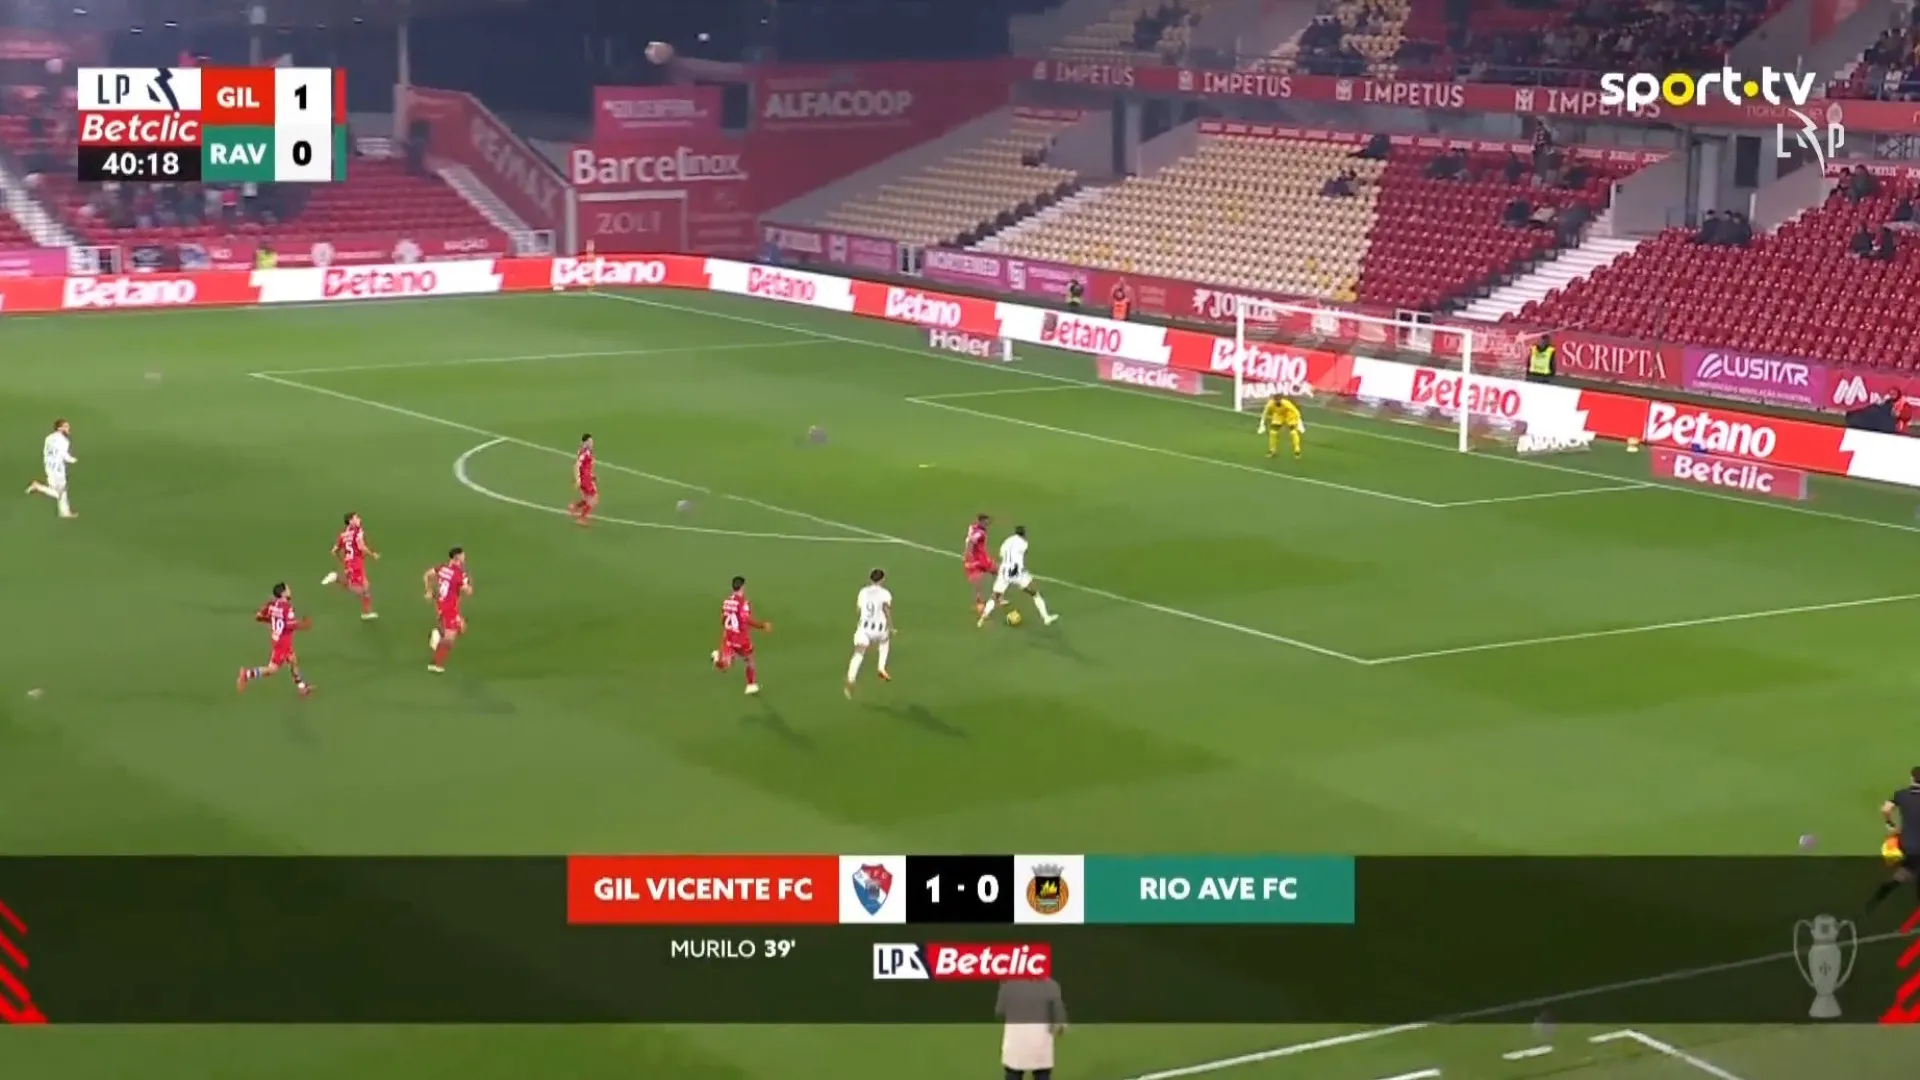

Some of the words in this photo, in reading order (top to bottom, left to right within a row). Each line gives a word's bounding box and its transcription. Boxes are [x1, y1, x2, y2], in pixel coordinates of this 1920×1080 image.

[1203, 72, 1292, 98] IMPETUS
[1363, 80, 1465, 108] IMPETUS
[763, 89, 914, 119] ALFACOOP
[322, 269, 438, 298] Betano
[553, 256, 665, 285] Betano
[63, 277, 197, 308] Betano
[885, 285, 961, 328] Betano
[1110, 360, 1181, 390] Betclic
[1210, 337, 1308, 383] Btano
[1561, 340, 1667, 380] SCRIPTA
[1723, 353, 1810, 387] LUSITAR
[1646, 400, 1777, 458] Betano
[1673, 454, 1774, 493] Betclic
